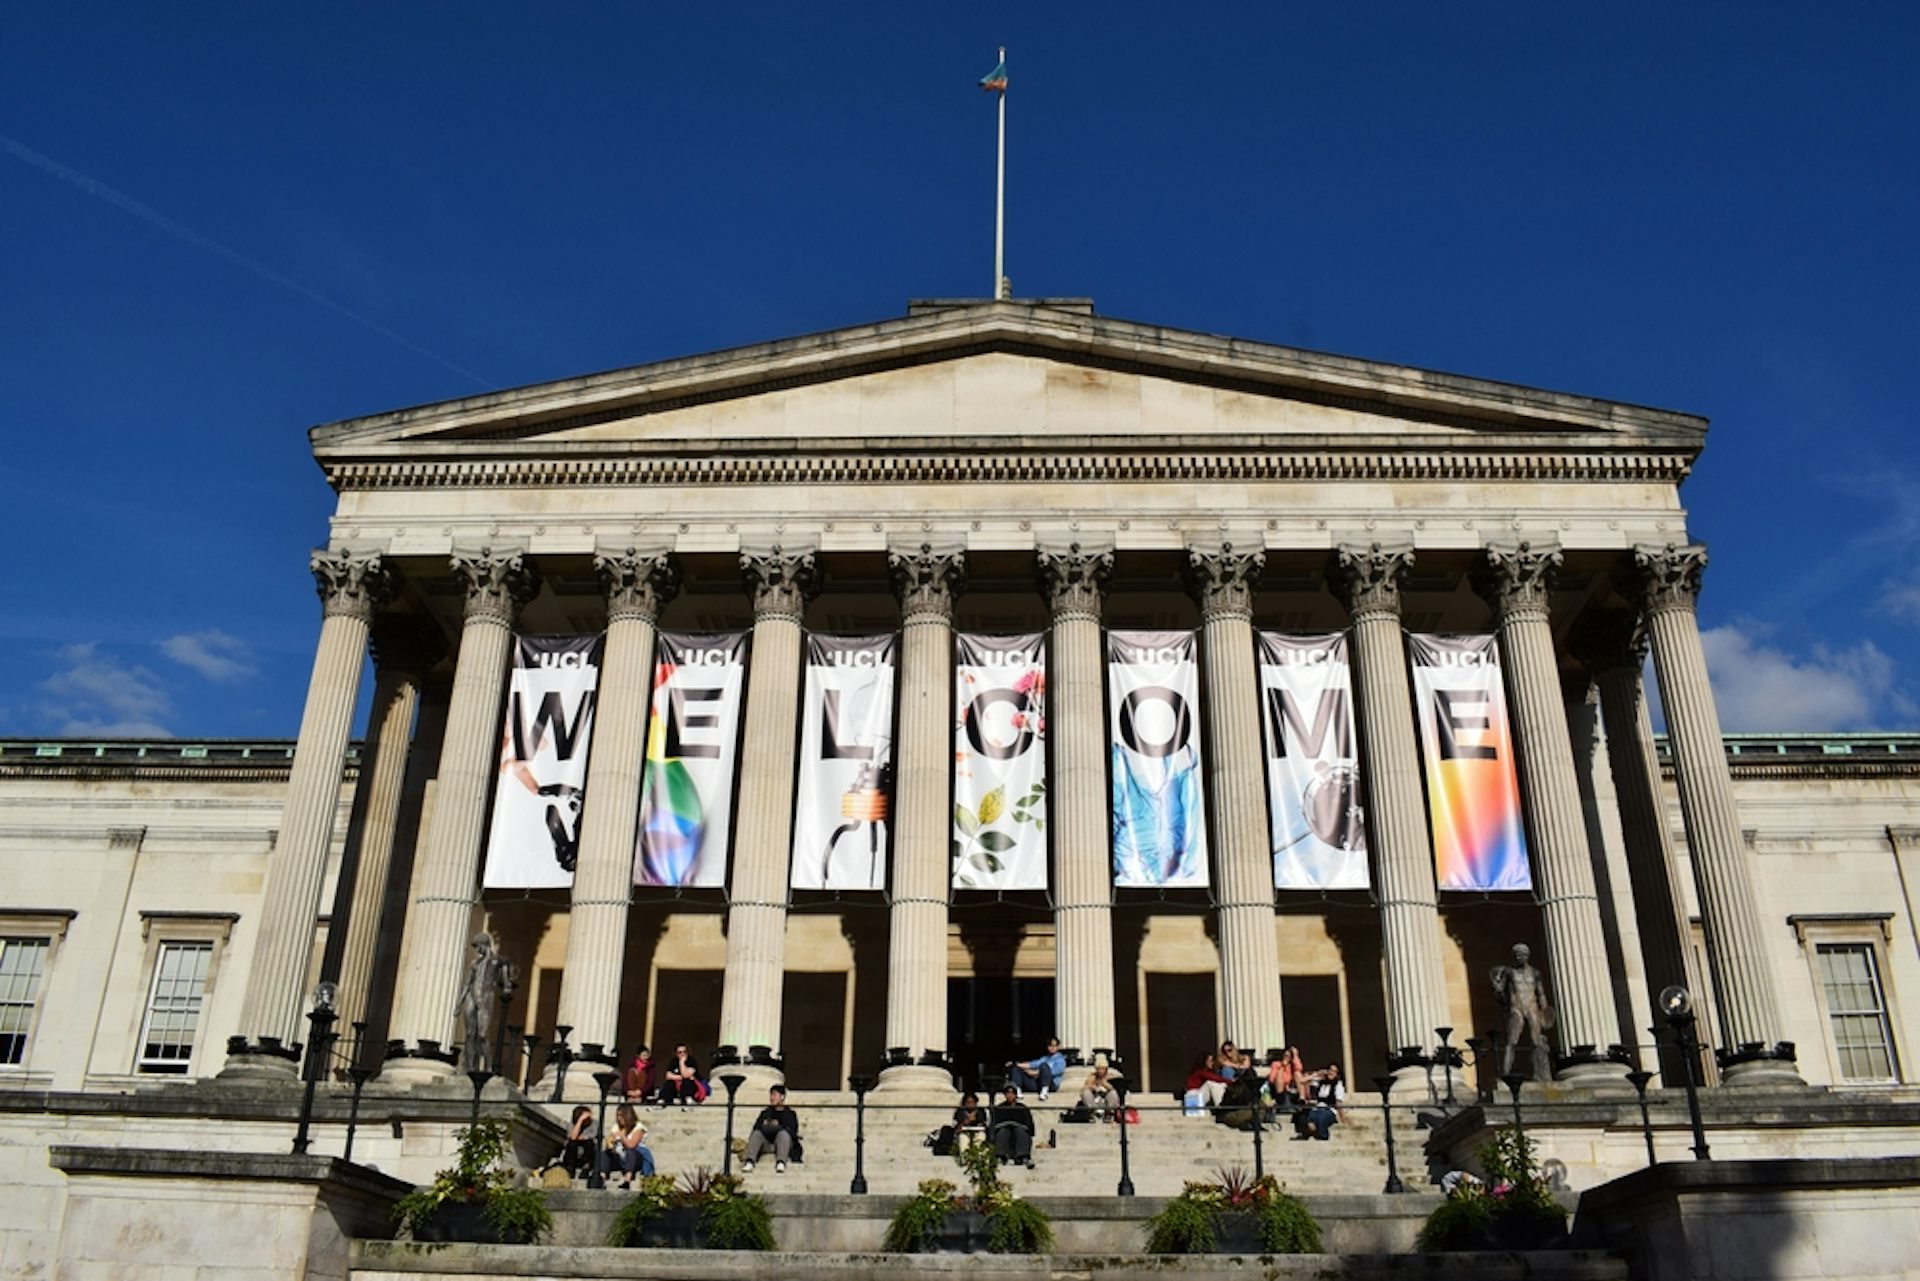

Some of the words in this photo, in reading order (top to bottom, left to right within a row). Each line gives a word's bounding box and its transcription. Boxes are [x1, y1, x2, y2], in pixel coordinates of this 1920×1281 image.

[540, 652, 594, 669] UCL
[685, 649, 739, 666] UCL
[835, 650, 889, 667] UCL
[985, 650, 1039, 667] UCL
[1136, 648, 1191, 665] UCL
[1287, 648, 1342, 666] UCL
[1440, 651, 1495, 668] UCL
[512, 691, 596, 761] W
[665, 688, 723, 759] E
[821, 689, 874, 760] L
[966, 688, 1034, 760] C
[1119, 686, 1190, 757] O
[1267, 688, 1351, 758] M
[1434, 690, 1497, 760] E
